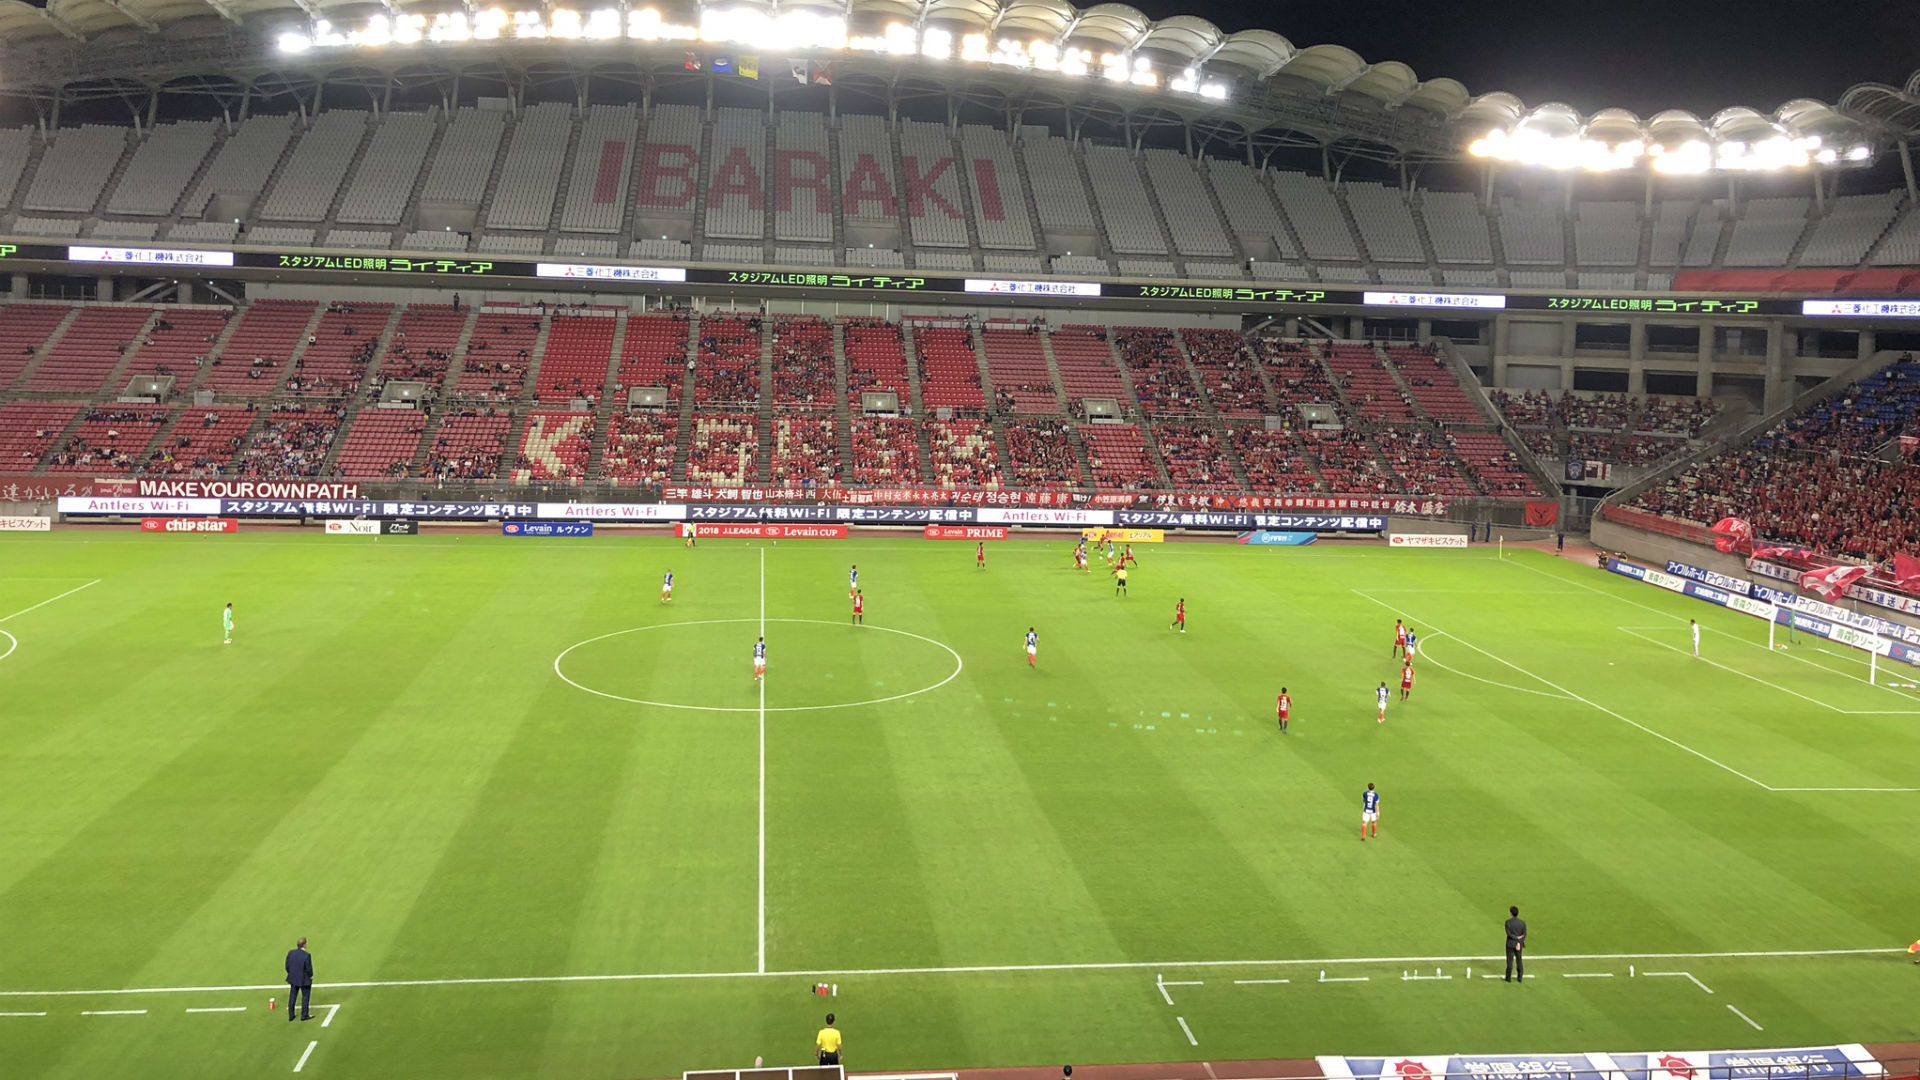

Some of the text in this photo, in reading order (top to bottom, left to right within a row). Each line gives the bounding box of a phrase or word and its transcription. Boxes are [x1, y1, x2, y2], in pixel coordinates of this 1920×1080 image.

[593, 139, 1006, 223] IBARAKI
[279, 255, 387, 271] スタジアムLED照明
[728, 271, 828, 286] スタジアムLED照明
[1140, 286, 1233, 300] スタジアムLED照明
[1548, 296, 1653, 311] スタジアムLED照明
[140, 480, 198, 497] MAKE
[200, 482, 254, 498] YOUR
[256, 482, 305, 499] OWN
[306, 483, 358, 499] PATH
[88, 499, 189, 511] Antlers Wi-Fi
[565, 505, 658, 517] Antlers Wi-Fi
[1002, 510, 1088, 522] Antlers Wi-Fi
[523, 524, 553, 532] Levain
[698, 527, 719, 535] 2018
[722, 527, 761, 535] J.LEAGUE
[784, 526, 819, 537] Levain
[820, 529, 838, 537] CUP
[966, 528, 1004, 538] PRIME
